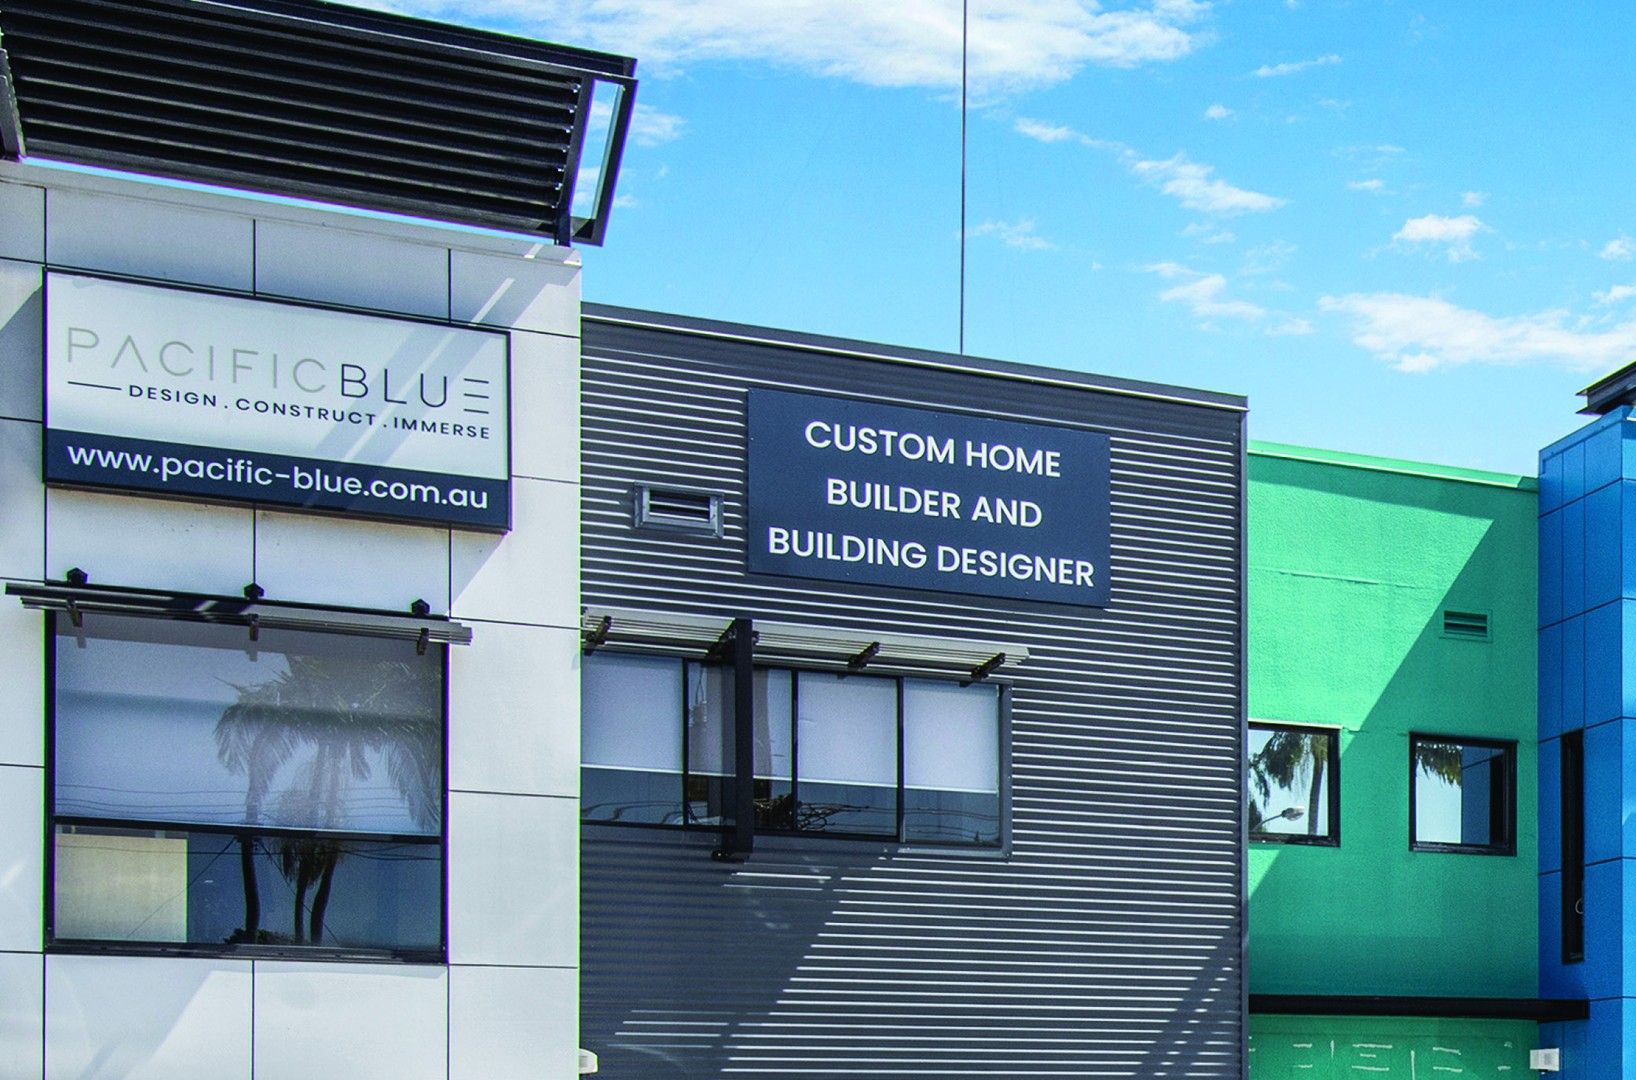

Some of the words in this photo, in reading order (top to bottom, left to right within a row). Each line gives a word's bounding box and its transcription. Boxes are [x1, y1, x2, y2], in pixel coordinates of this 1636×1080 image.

[67, 327, 490, 414] PACIFICBLUE
[67, 444, 488, 509] www.pacific-blue.com.au
[805, 420, 955, 465] CUSTOM
[966, 440, 1061, 477] HOME
[827, 478, 960, 518] BUILDER
[972, 496, 1042, 527] AND
[768, 526, 927, 569] BUILDING
[937, 545, 1094, 587] DESIGNER
